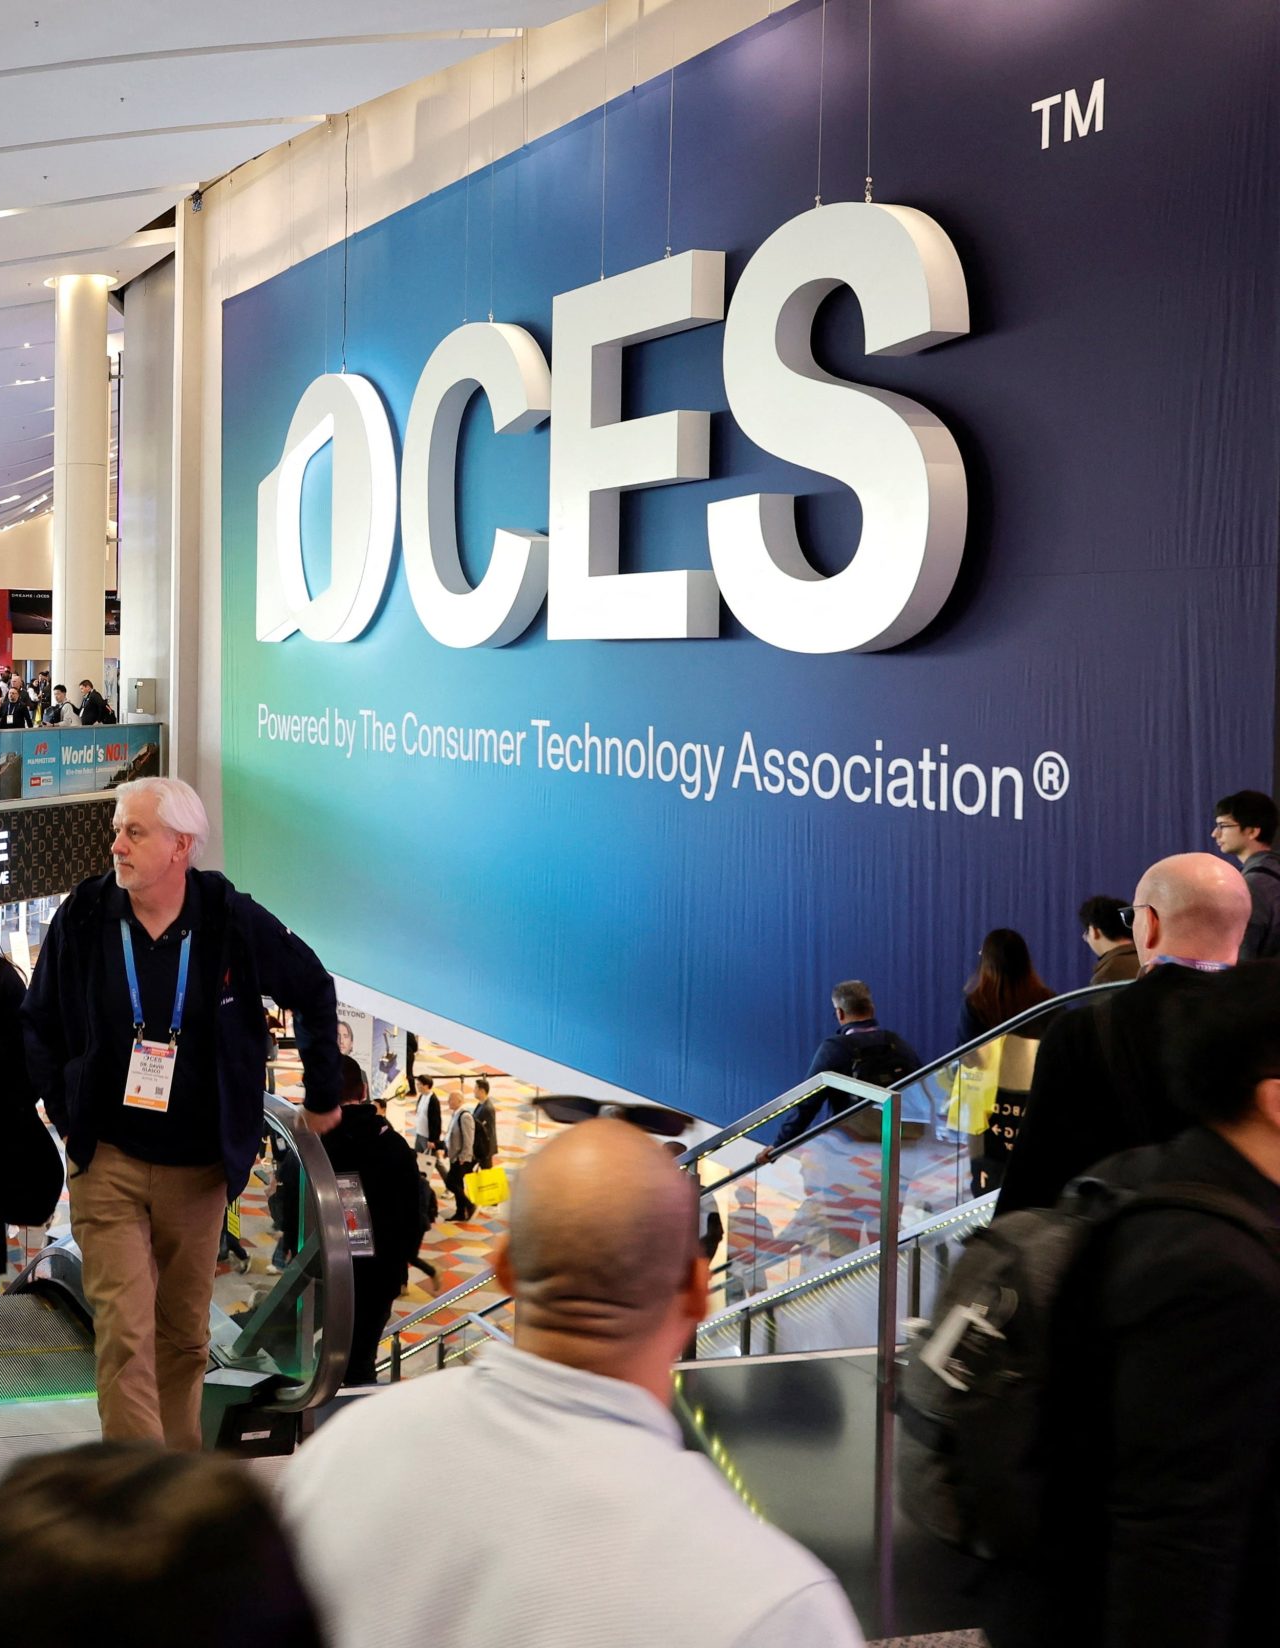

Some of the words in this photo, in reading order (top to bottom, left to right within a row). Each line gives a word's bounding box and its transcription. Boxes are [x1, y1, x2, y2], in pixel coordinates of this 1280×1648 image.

[1032, 78, 1106, 150] TM
[400, 202, 970, 654] CES
[61, 744, 105, 765] World's
[106, 743, 128, 761] NO.1
[257, 703, 330, 748] Powered
[334, 706, 357, 758] by
[359, 709, 396, 753] The
[401, 712, 526, 767] Consumer
[531, 719, 725, 802] Technology
[337, 1009, 366, 1019] BEYOND
